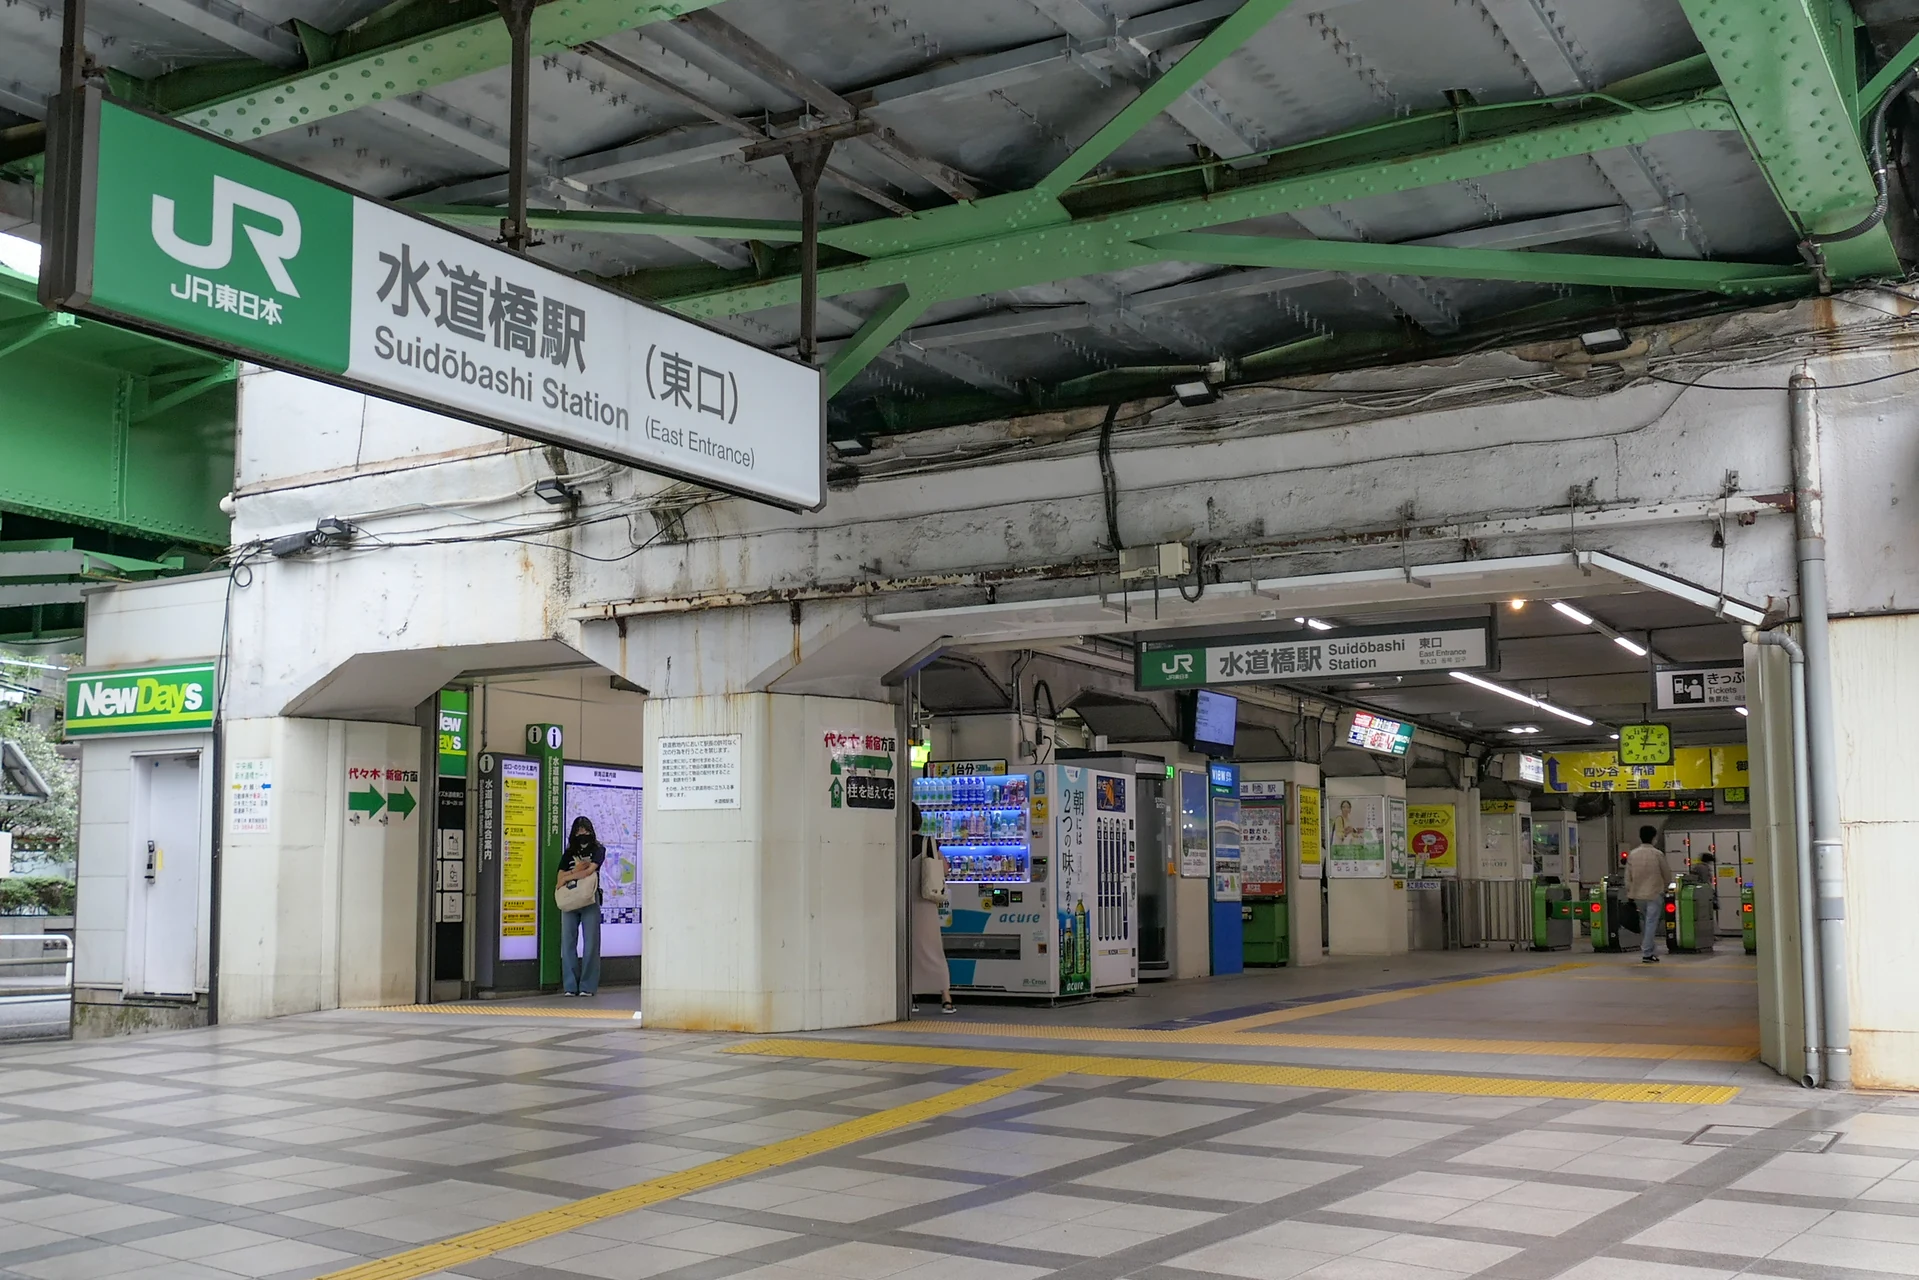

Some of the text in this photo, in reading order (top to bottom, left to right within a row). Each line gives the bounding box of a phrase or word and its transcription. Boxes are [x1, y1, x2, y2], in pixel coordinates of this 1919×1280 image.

[151, 174, 302, 299] JR
[170, 273, 283, 326] JR東日本
[376, 243, 586, 374] 水道橋駅
[373, 325, 629, 431] Suidōbashi Station
[645, 415, 755, 470] (East Entrance)
[1328, 639, 1406, 656] Suidōbashi
[1418, 637, 1442, 649] 東口
[1219, 646, 1322, 677] 水道橋駅
[1418, 649, 1467, 658] East Entrance
[1161, 653, 1194, 674] JR
[1328, 658, 1377, 671] Station
[1166, 673, 1189, 681] JR東日本
[76, 678, 203, 718] NewDays
[1707, 686, 1737, 694] Tickets
[439, 735, 461, 752] ays
[348, 767, 419, 782] 代々木・新宿方面
[847, 783, 895, 800] 柱を越えて右
[484, 778, 493, 861] 水道橋駅総合案内
[1073, 789, 1085, 846] 朝には
[999, 913, 1041, 923] acure
[1066, 981, 1084, 991] acure
